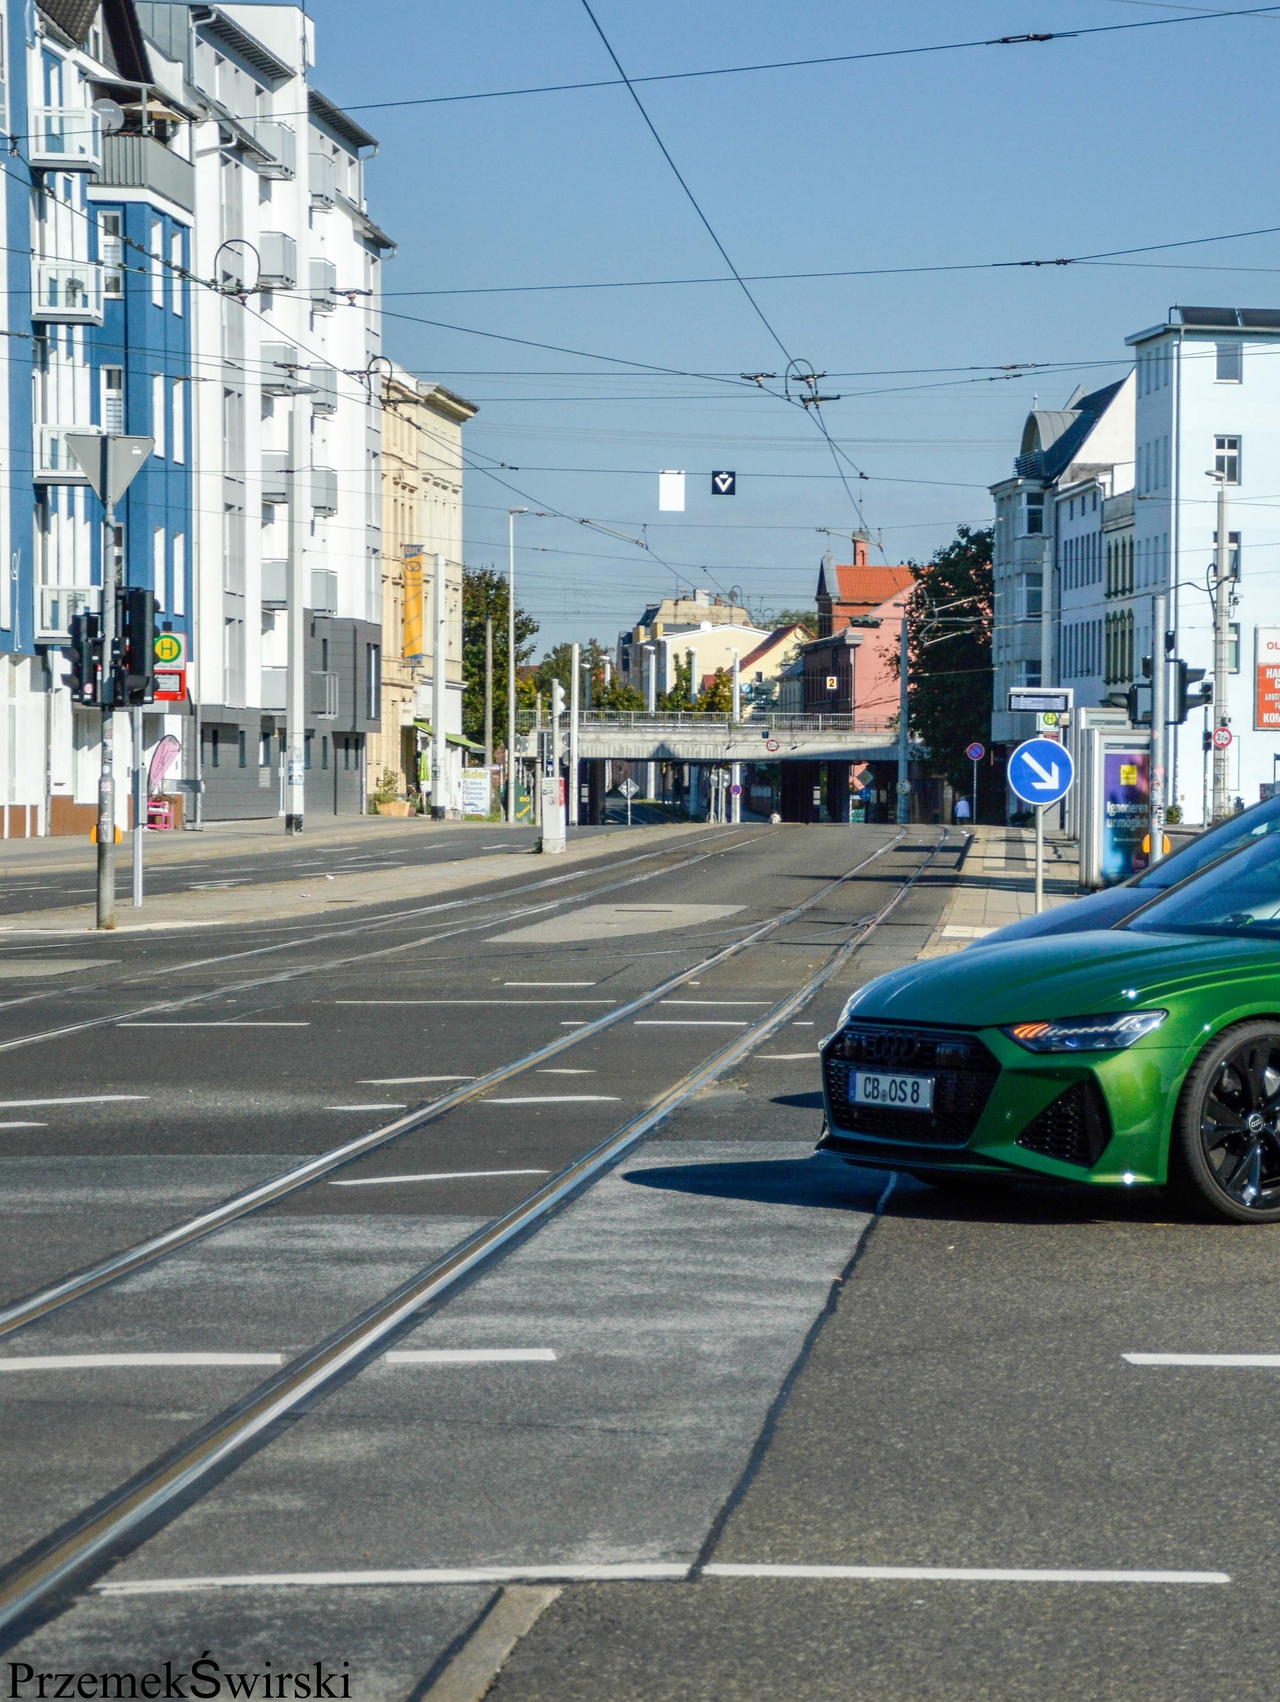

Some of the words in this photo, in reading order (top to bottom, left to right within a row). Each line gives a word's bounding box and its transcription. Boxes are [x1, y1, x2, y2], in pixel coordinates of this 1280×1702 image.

[161, 641, 173, 657] H
[1107, 801, 1149, 816] Ignorieren
[1107, 817, 1149, 832] unmöglich
[911, 1081, 921, 1104] 8
